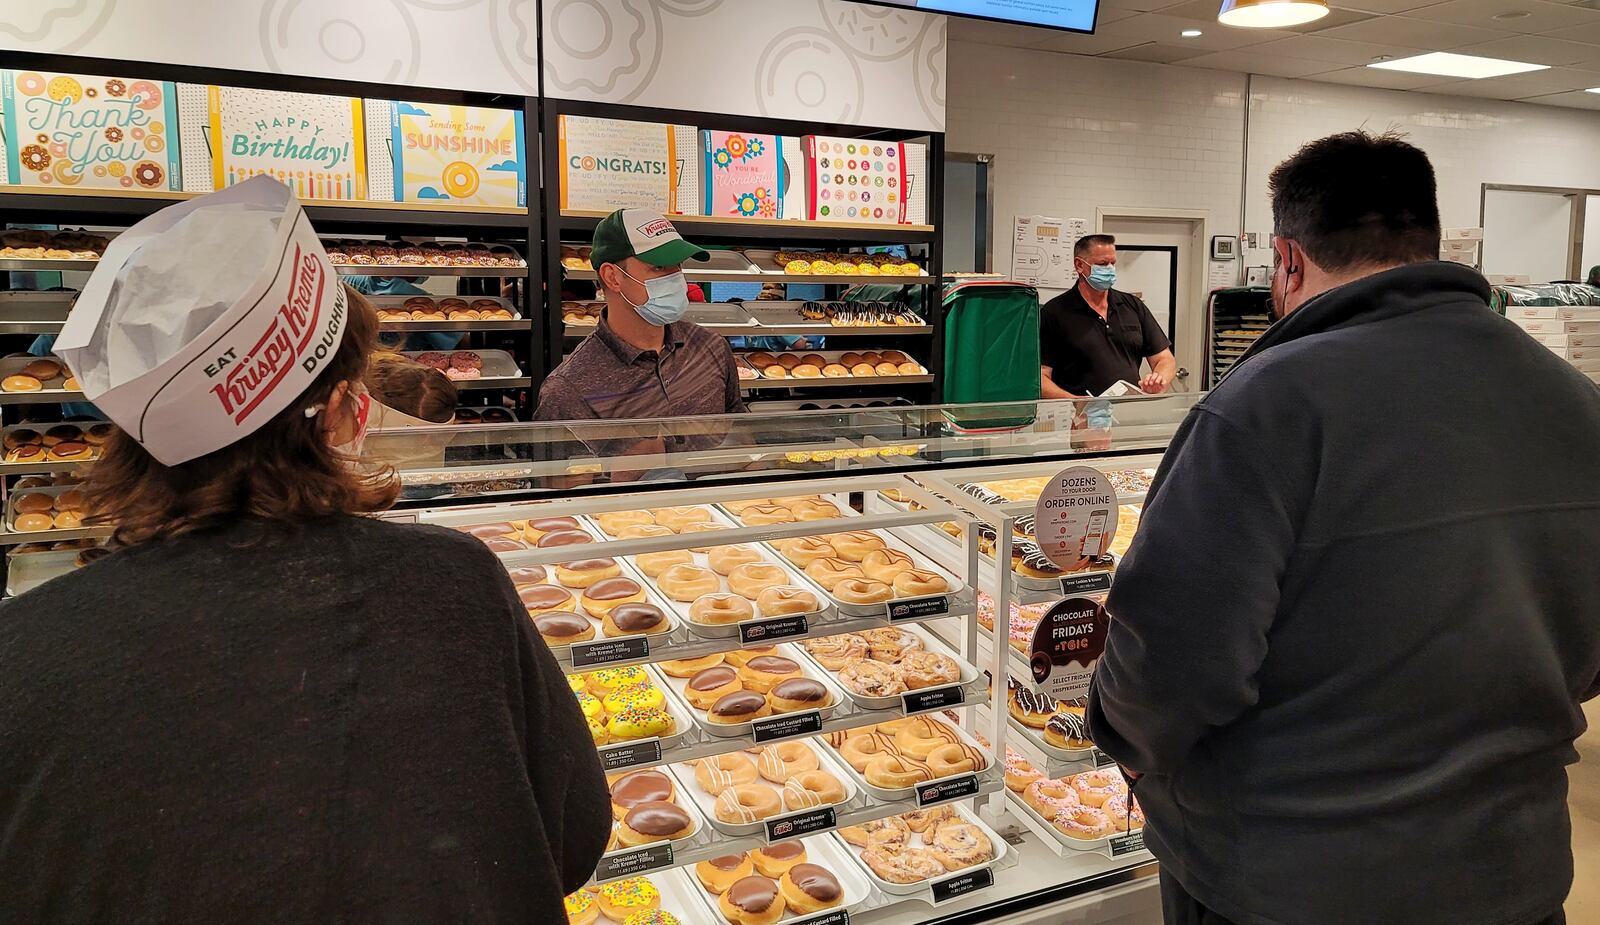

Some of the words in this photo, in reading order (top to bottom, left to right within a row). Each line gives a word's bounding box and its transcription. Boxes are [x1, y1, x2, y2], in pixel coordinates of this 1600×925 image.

[25, 95, 151, 130] Thank
[255, 117, 323, 136] HAPPY
[429, 120, 462, 134] Sending
[463, 122, 486, 132] Some
[53, 130, 144, 174] You
[231, 134, 349, 169] Birthday!
[405, 133, 512, 156] SUNSHINE
[570, 156, 667, 175] CONGRATS!
[209, 316, 296, 425] Krispy
[279, 241, 325, 357] Kreme
[203, 347, 238, 378] EAT
[1062, 477, 1097, 488] DOZENS
[1045, 500, 1075, 509] ORDER
[1077, 496, 1110, 506] ONLINE
[1052, 609, 1094, 622] CHOCOLATE
[1052, 623, 1094, 639] FRIDAYS
[1052, 676, 1071, 684] SELECT
[1071, 673, 1092, 681] FRIDAYS
[793, 817, 810, 825] Original
[612, 854, 638, 864] Chocolate
[637, 851, 648, 859] Iced
[639, 856, 655, 864] Filling
[829, 915, 842, 923] Filled
